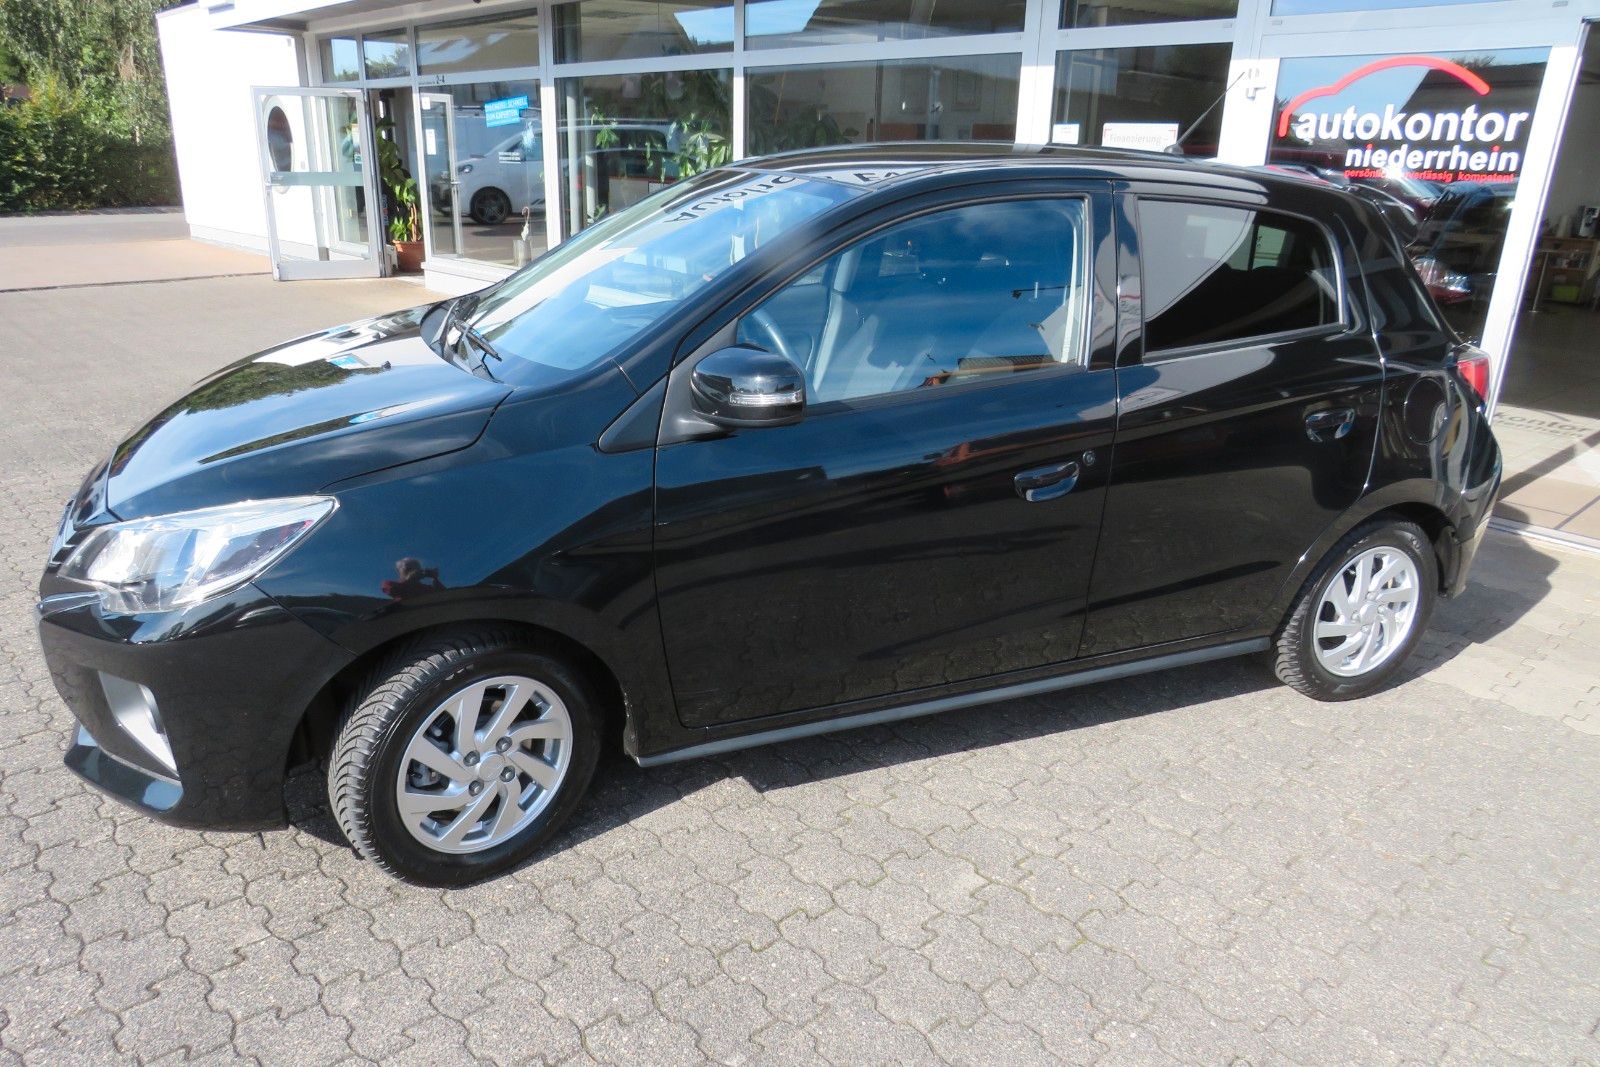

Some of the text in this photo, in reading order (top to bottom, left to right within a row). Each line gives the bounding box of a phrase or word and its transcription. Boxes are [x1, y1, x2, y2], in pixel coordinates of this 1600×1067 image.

[1295, 104, 1529, 143] autokontor
[1344, 143, 1520, 171] niederrhein
[1458, 171, 1515, 184] kompetent
